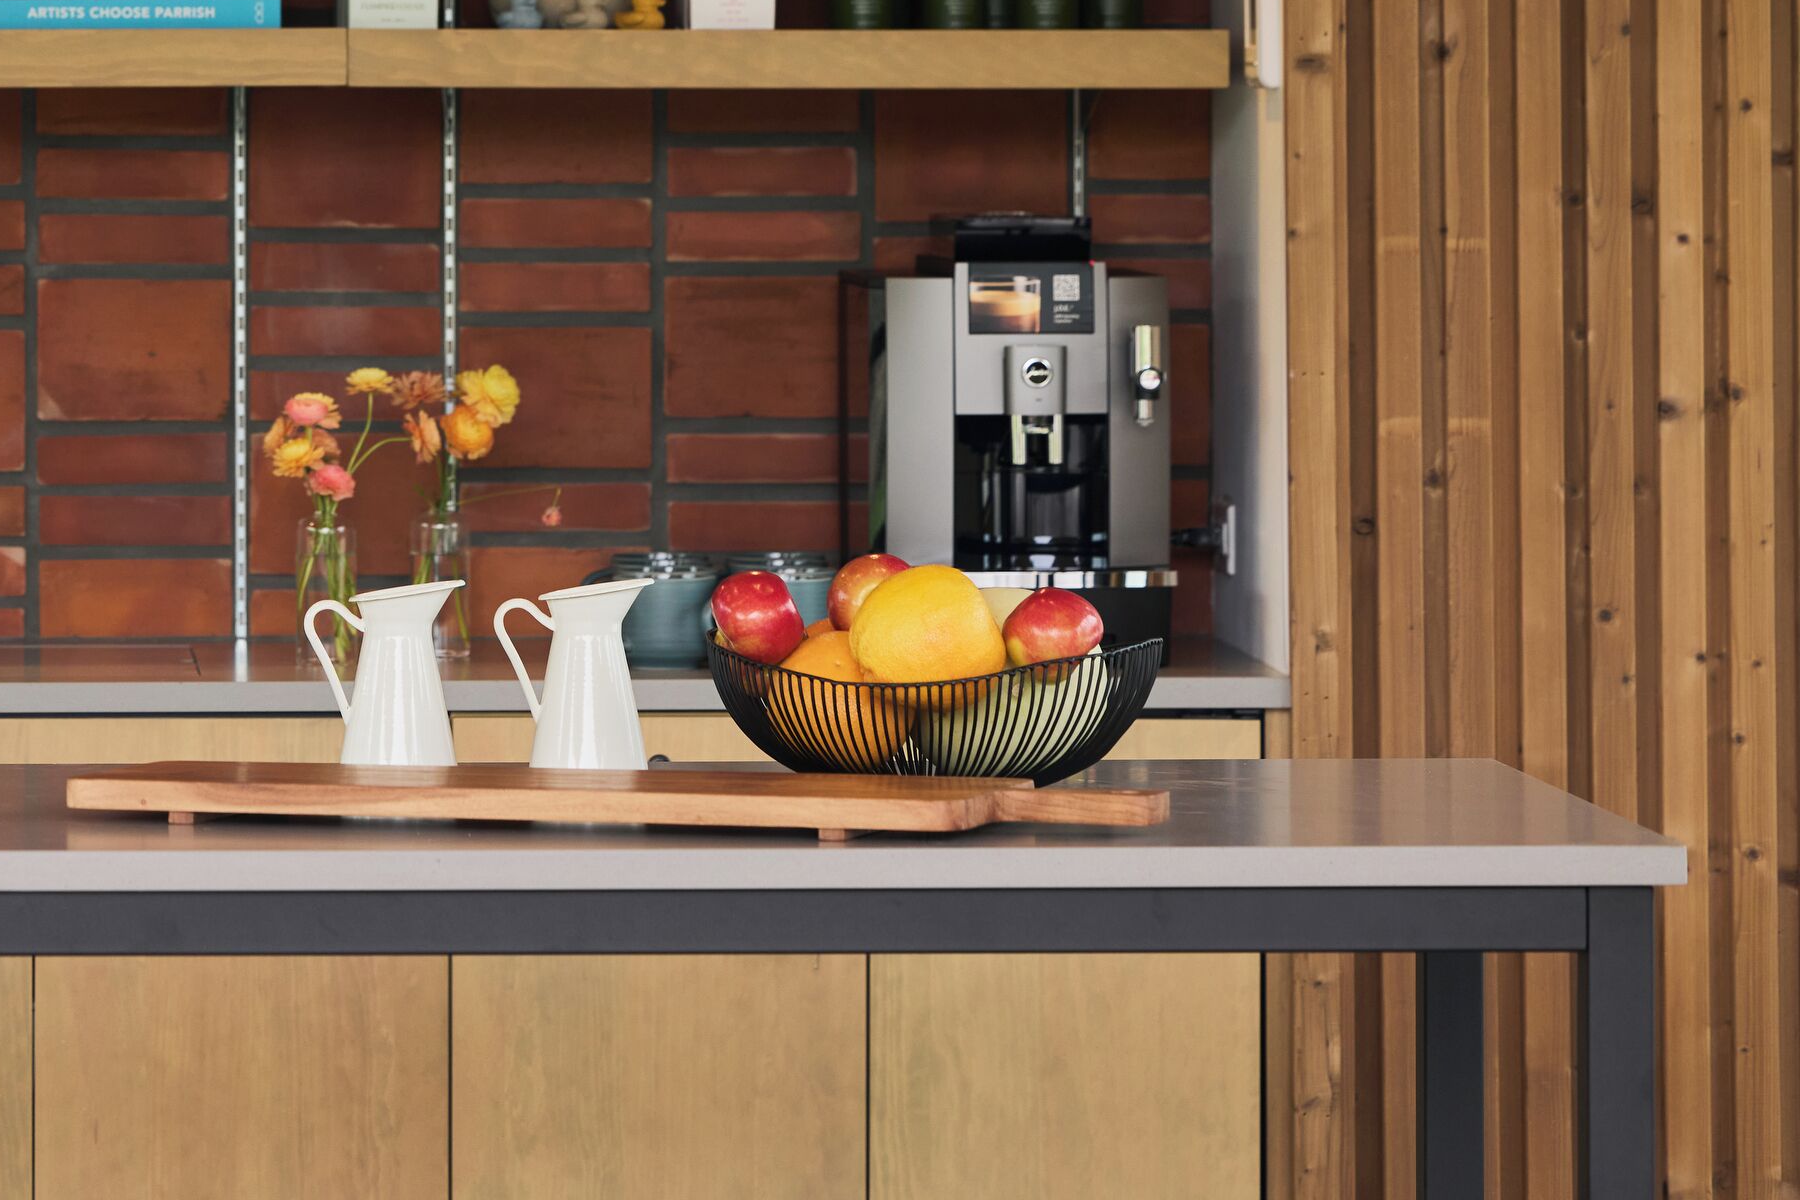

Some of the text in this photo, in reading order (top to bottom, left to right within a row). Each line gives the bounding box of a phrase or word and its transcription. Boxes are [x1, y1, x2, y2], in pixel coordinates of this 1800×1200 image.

[27, 6, 216, 19] ARTISTS CHOOSE PARRISH
